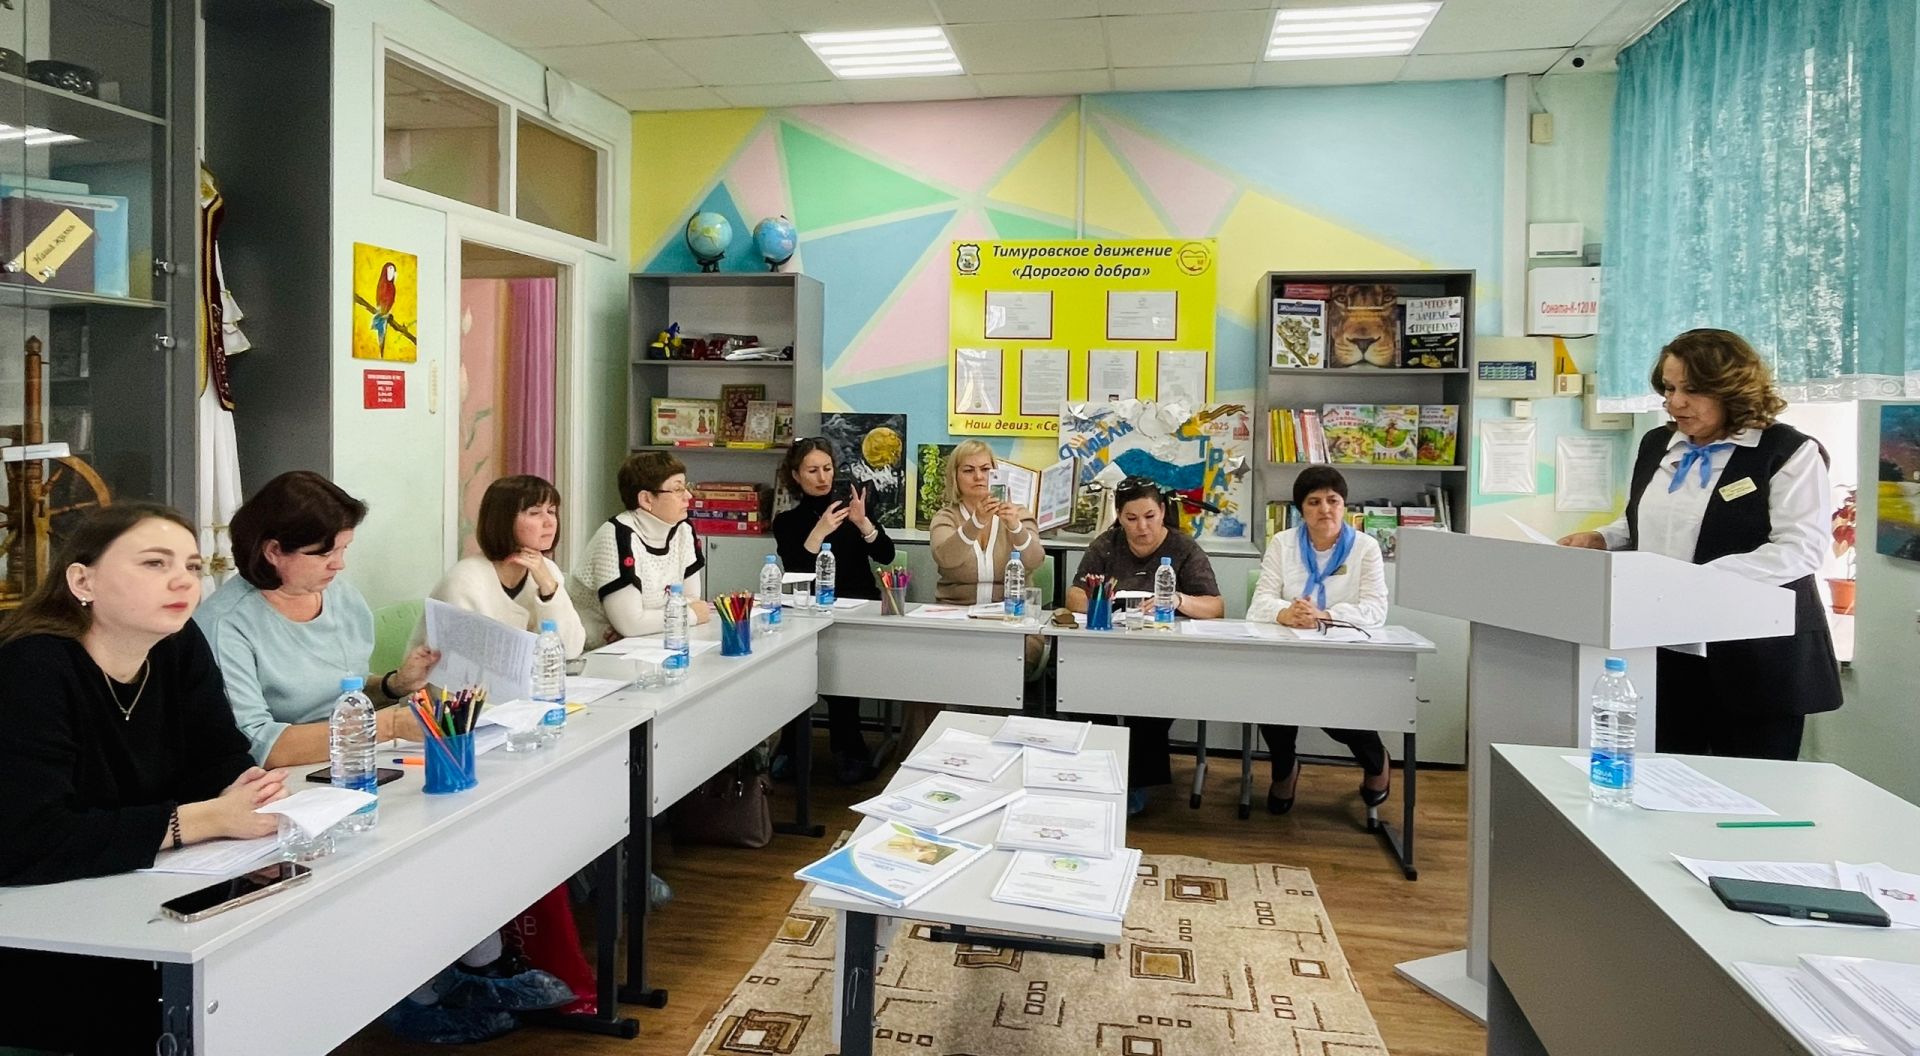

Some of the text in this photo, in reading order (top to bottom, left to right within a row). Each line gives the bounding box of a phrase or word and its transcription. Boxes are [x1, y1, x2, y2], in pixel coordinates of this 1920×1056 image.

[992, 244, 1173, 259] Тимуровское движение
[1012, 264, 1151, 279] «Дорогою добра»
[965, 420, 1060, 432] Наш девиз: «Се
